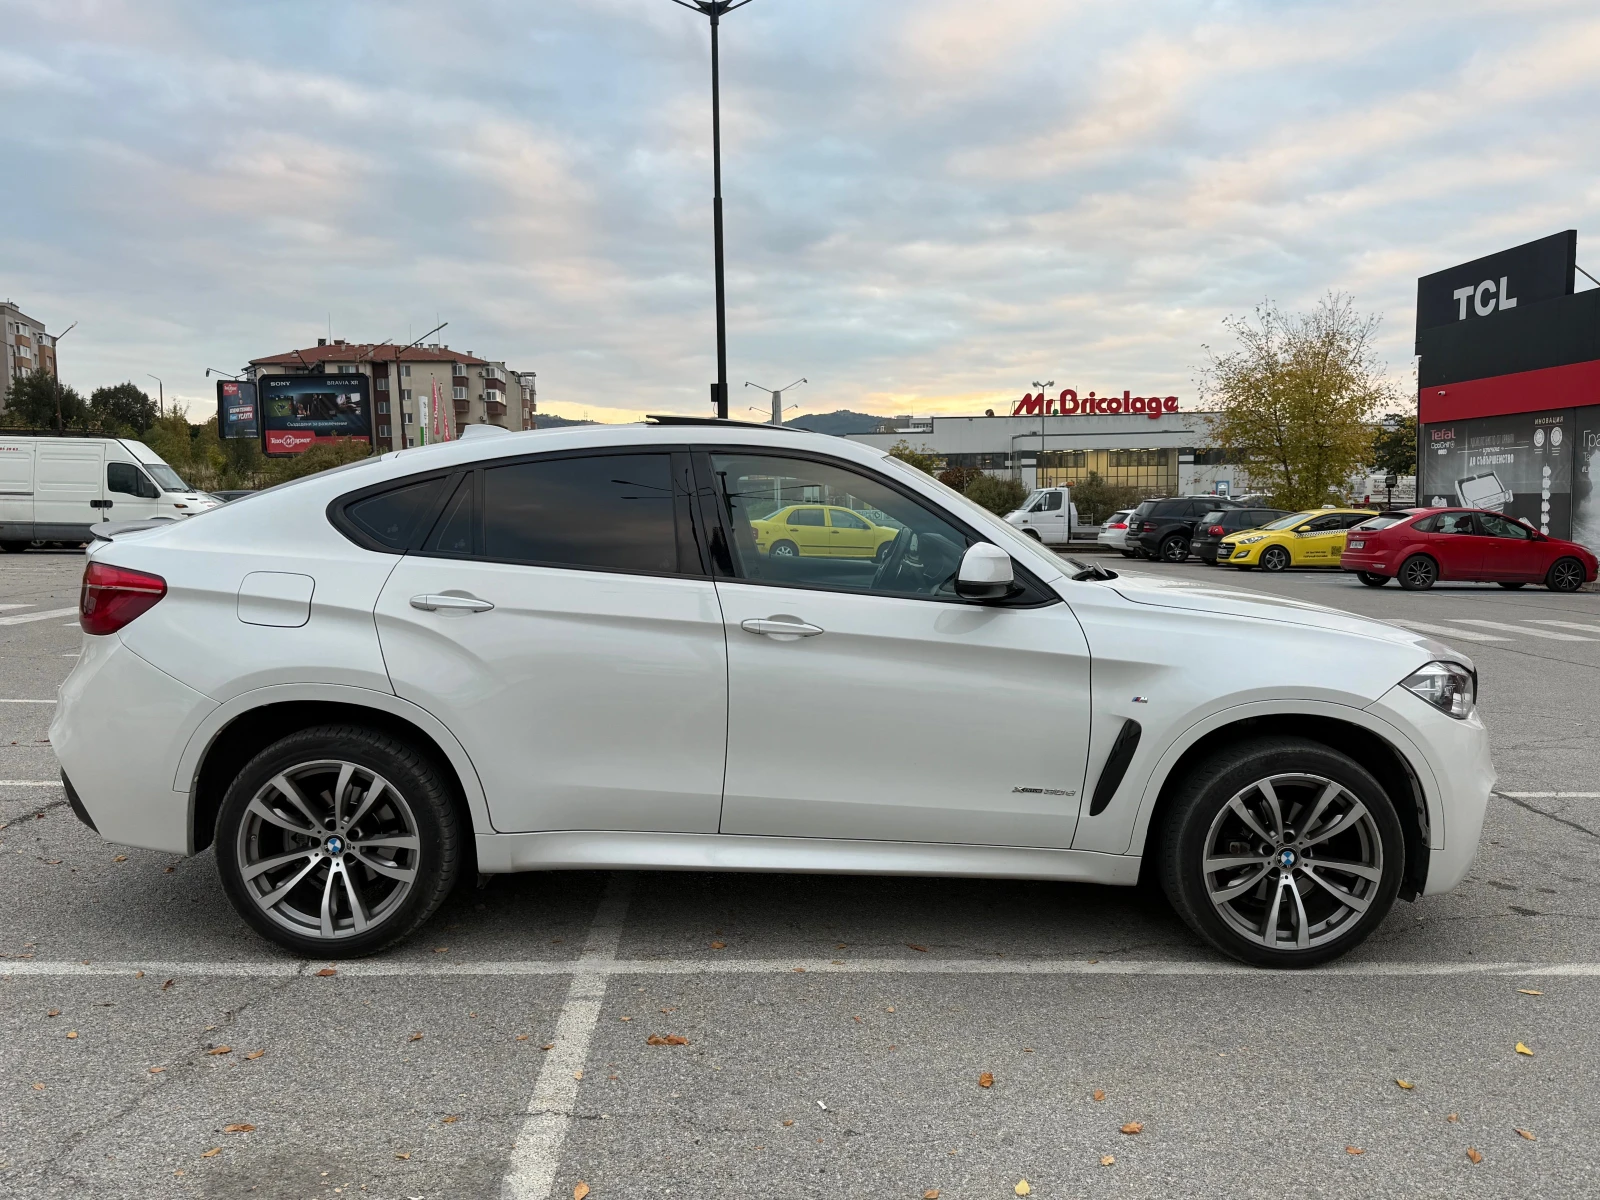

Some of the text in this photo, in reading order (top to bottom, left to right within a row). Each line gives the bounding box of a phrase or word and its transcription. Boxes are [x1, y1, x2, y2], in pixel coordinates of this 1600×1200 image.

[1453, 276, 1517, 320] TCL
[1534, 416, 1564, 425] ИНОВАЦИЯ
[1430, 428, 1456, 441] Tefal
